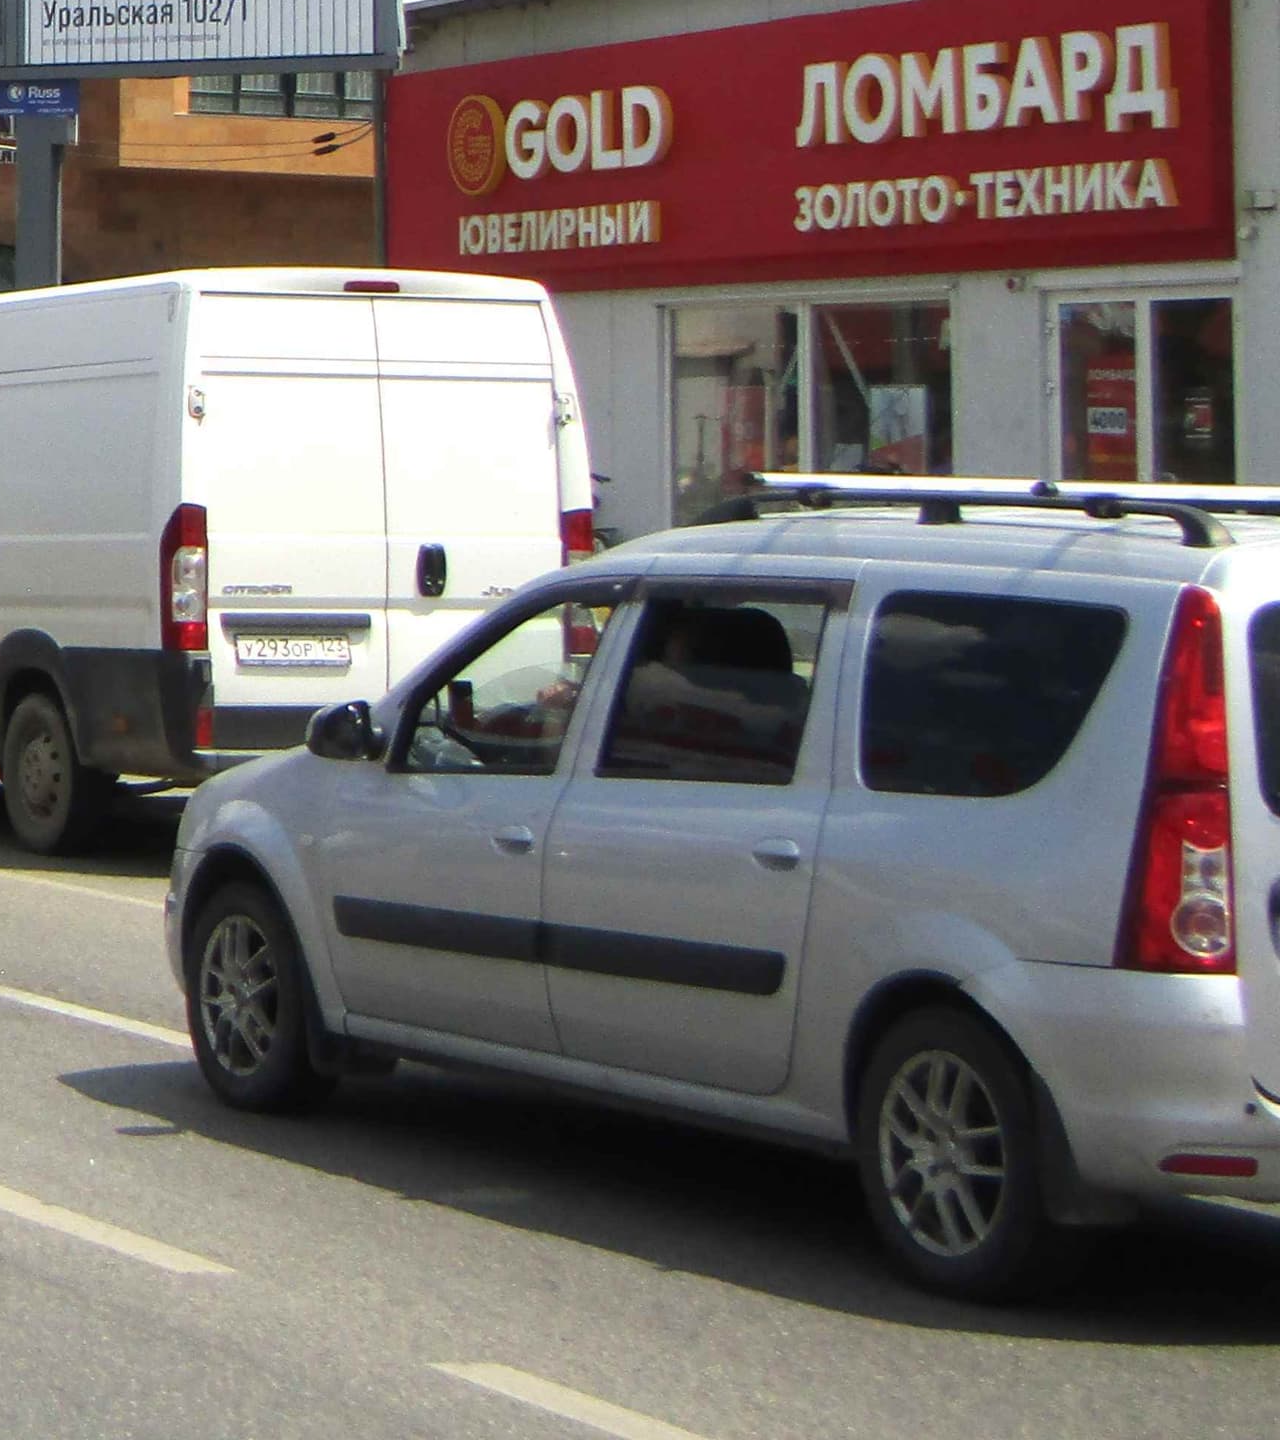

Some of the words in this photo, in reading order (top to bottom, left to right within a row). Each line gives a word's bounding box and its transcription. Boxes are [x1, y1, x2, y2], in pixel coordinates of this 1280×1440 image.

[43, 0, 174, 32] Уральская
[28, 85, 61, 99] Russ
[796, 22, 1181, 148] ЛОМБАРД
[505, 85, 675, 181] GOLD
[793, 173, 958, 232] ЗОЛОТО
[970, 158, 1181, 219] ТЕХНИКА
[459, 200, 662, 256] ЮВЕЛИРНЫЙ
